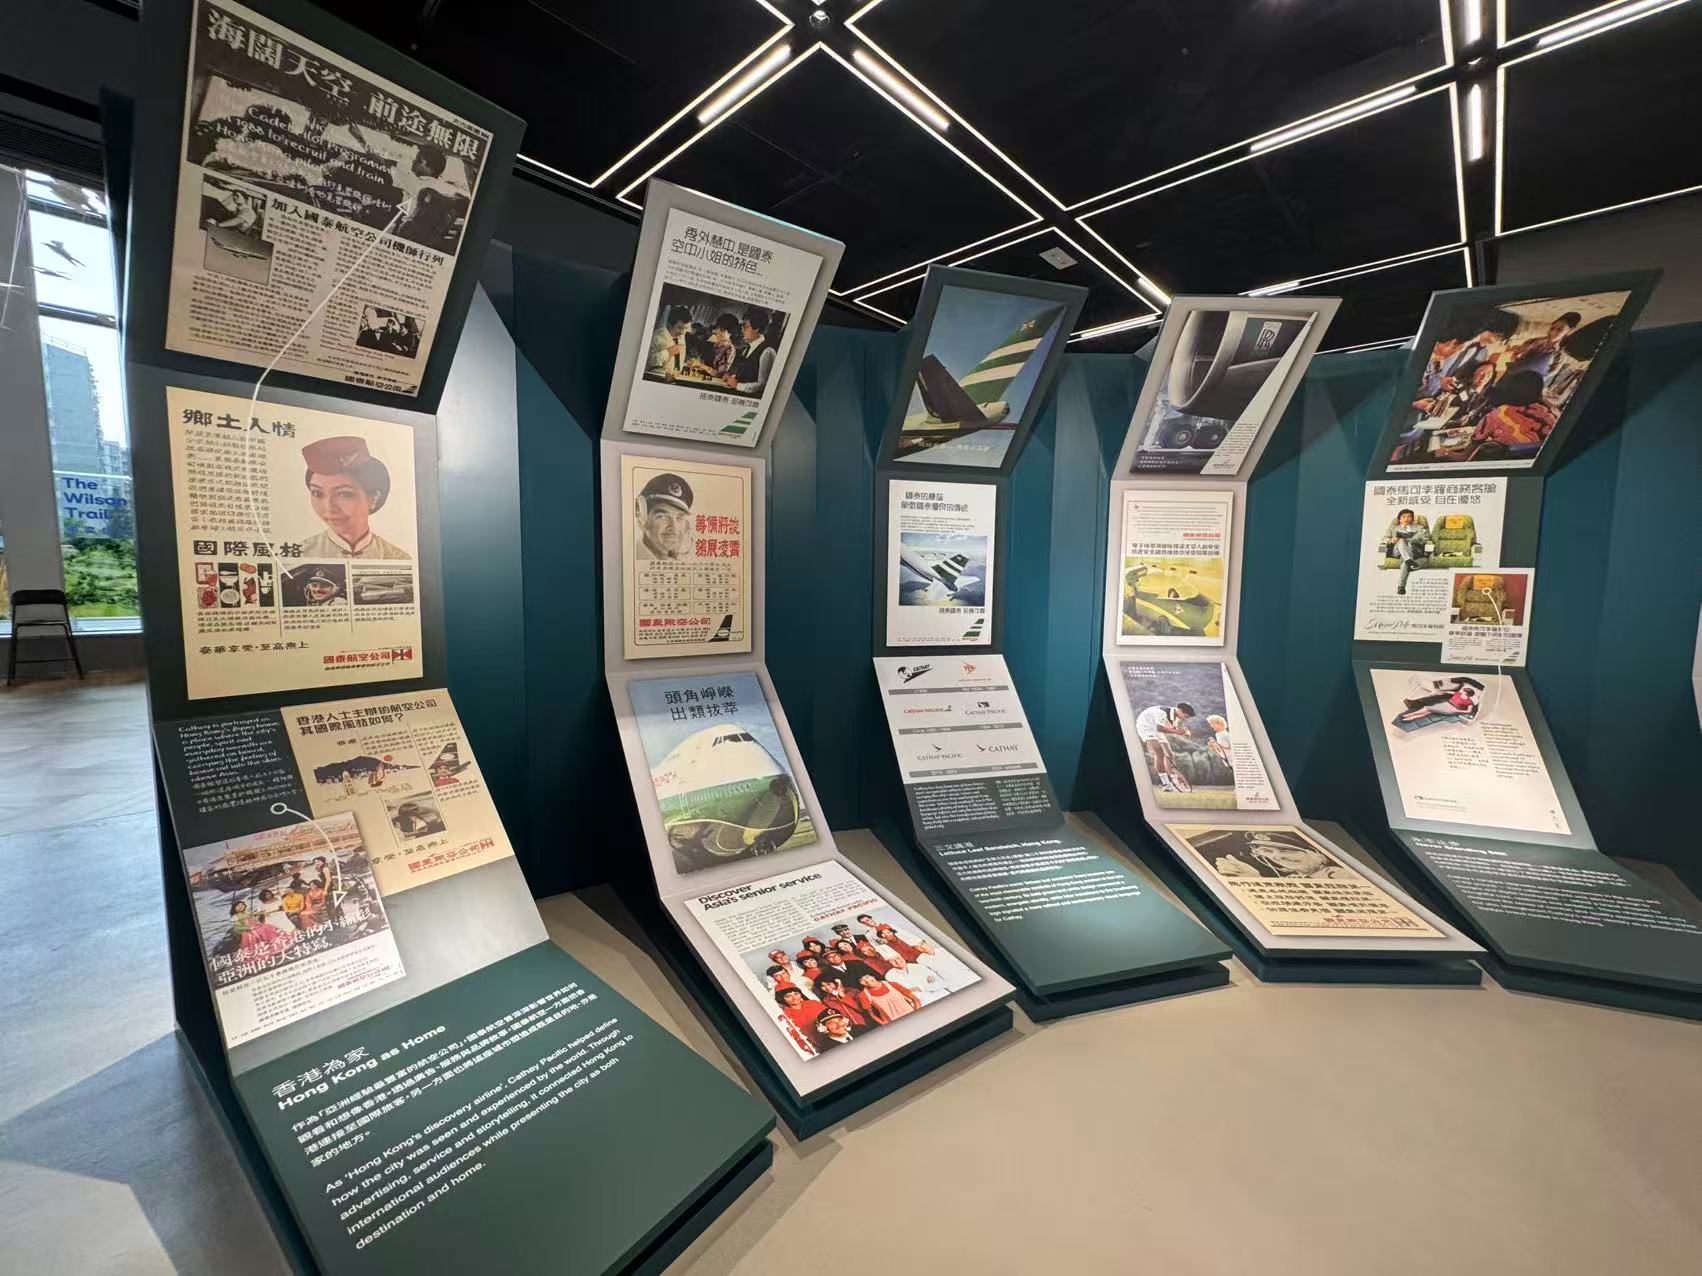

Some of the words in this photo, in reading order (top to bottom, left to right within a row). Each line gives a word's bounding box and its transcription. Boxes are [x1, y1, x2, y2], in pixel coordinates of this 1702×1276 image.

[208, 8, 353, 102] 海闊天空
[368, 92, 479, 160] 前途無限
[268, 128, 283, 142] to
[283, 137, 327, 161] recruit
[330, 154, 355, 172] and
[357, 165, 385, 185] train
[270, 198, 444, 266] 加入國泰航空公司機師行列
[182, 408, 297, 438] 鄉土人情
[61, 477, 98, 490] The
[64, 492, 127, 507] Wilson
[64, 507, 109, 520] Trail
[193, 540, 304, 558] 國際風格
[323, 651, 390, 664] 國泰航空公司
[664, 686, 735, 704] 頭角崢嶸
[296, 699, 437, 726] 香港人士主辦的航空公司
[671, 701, 739, 721] 出類拔萃
[988, 744, 1018, 752] CATHAY
[699, 884, 752, 904] Discover
[704, 897, 739, 911] Asia's
[739, 886, 777, 901] senior
[779, 872, 822, 889] service
[814, 909, 845, 921] CATHAY
[272, 1046, 370, 1098] 香港為家
[278, 1082, 329, 1110] Hong
[331, 1058, 378, 1085] Kong
[380, 1048, 400, 1061] as
[401, 1025, 446, 1050] Home
[326, 1179, 343, 1193] As
[383, 1133, 422, 1158] Kong's
[424, 1103, 472, 1134] discovery
[507, 1063, 540, 1085] Cathay
[540, 1047, 568, 1066] Pacific
[568, 1031, 595, 1049] helped
[595, 1018, 618, 1034] define
[331, 1187, 359, 1206] how
[361, 1173, 382, 1189] the
[384, 1159, 404, 1175] city
[406, 1144, 431, 1161] was
[431, 1127, 458, 1146] seen
[459, 1113, 479, 1129] and
[480, 1079, 537, 1117] experienced
[536, 1071, 549, 1083] by
[548, 1062, 564, 1075] the
[563, 1049, 589, 1065] world.
[587, 1028, 621, 1049] Through
[339, 1174, 412, 1221] advertising,
[412, 1147, 453, 1175] service
[454, 1132, 476, 1149] and
[476, 1099, 532, 1136] storytelling,
[530, 1091, 539, 1101] it
[538, 1066, 583, 1096] connected
[581, 1052, 606, 1069] Hong
[603, 1038, 627, 1056] Kong
[624, 1034, 634, 1043] to
[347, 1181, 425, 1235] international
[425, 1145, 482, 1185] audiences
[482, 1128, 510, 1148] while
[510, 1096, 559, 1132] presenting
[558, 1086, 574, 1099] the
[574, 1075, 589, 1089] city
[589, 1068, 601, 1079] as
[599, 1056, 620, 1071] both
[355, 1200, 425, 1250] destination
[427, 1183, 450, 1203] and
[450, 1162, 487, 1187] home.
